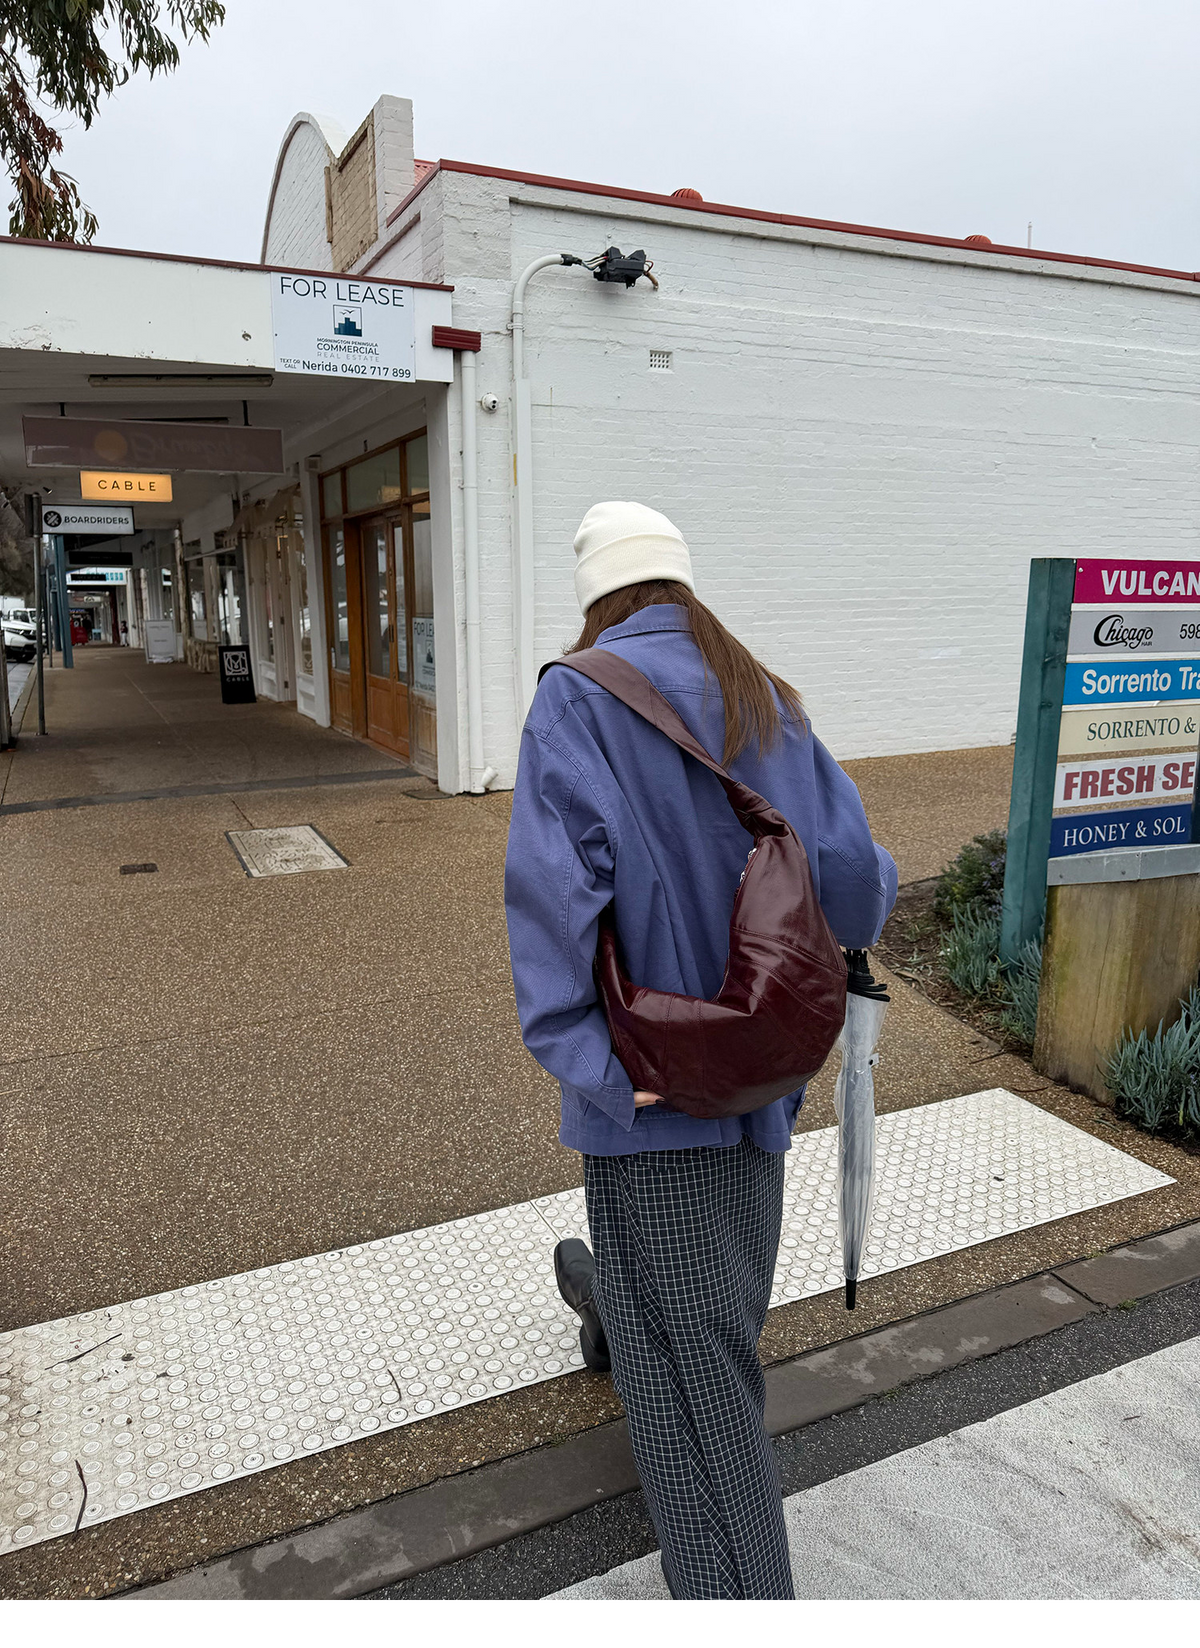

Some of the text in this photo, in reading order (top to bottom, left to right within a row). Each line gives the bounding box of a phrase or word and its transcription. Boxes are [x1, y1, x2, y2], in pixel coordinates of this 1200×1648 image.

[280, 276, 404, 307] FOR LEASE
[316, 337, 350, 345] MORNINGTON
[316, 342, 379, 355] COMMERCIAL
[302, 360, 411, 378] Nerida 0402 717 899
[317, 351, 379, 362] REAL ESTATE
[97, 479, 156, 492] CABLE
[64, 515, 129, 525] BOARDRIDERS
[1101, 569, 1200, 596] VULCAN
[1093, 614, 1154, 649] Chicago
[1082, 668, 1172, 695] Sorrento
[1087, 716, 1197, 741] SORRENTO &
[1063, 761, 1195, 800] FRESH SE
[1063, 816, 1186, 847] HONEY & SOL
